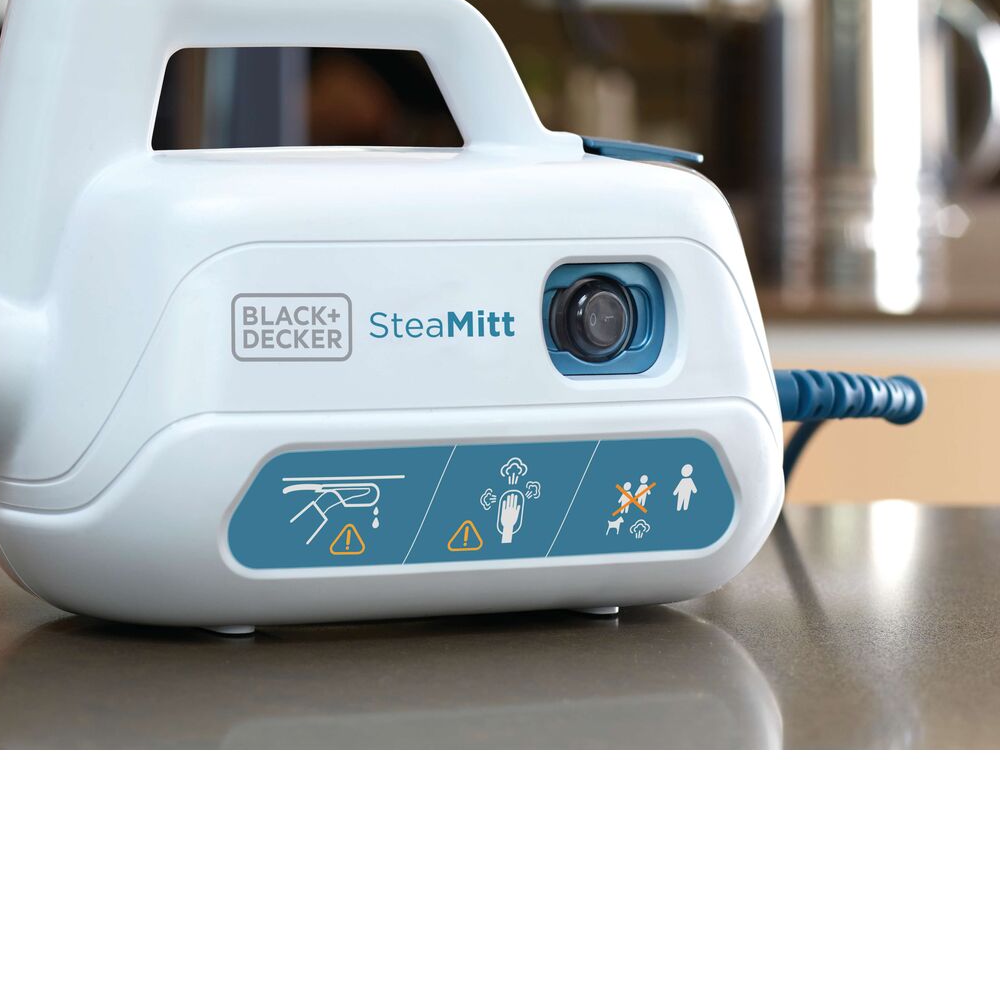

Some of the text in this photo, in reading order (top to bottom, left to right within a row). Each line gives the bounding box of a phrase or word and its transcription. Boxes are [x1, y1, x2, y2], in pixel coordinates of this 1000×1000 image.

[242, 306, 341, 326] BLACK+
[369, 310, 515, 339] SteaMitt
[242, 328, 343, 349] DECKER
